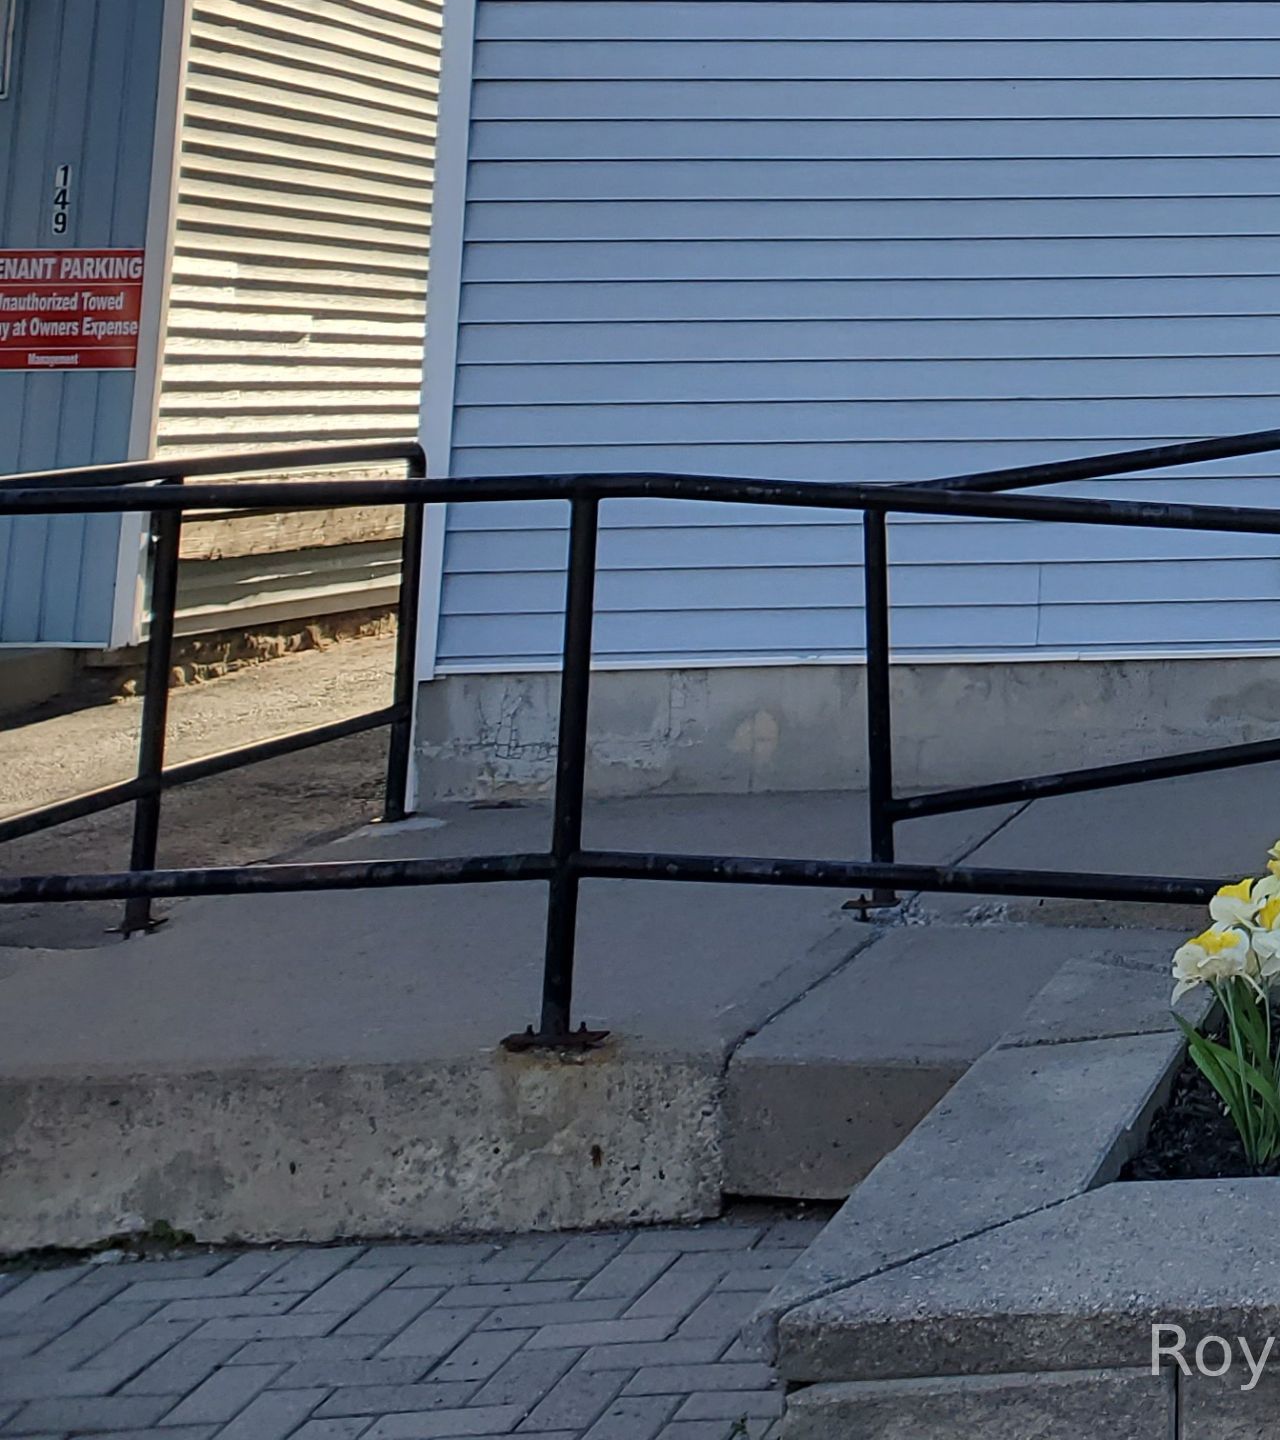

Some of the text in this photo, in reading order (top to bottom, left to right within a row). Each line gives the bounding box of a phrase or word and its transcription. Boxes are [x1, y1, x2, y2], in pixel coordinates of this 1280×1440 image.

[53, 164, 71, 234] 149
[60, 257, 143, 279] PARKING
[81, 291, 125, 311] Towed
[12, 319, 27, 336] at
[29, 317, 79, 336] Owners
[82, 317, 138, 340] Expense
